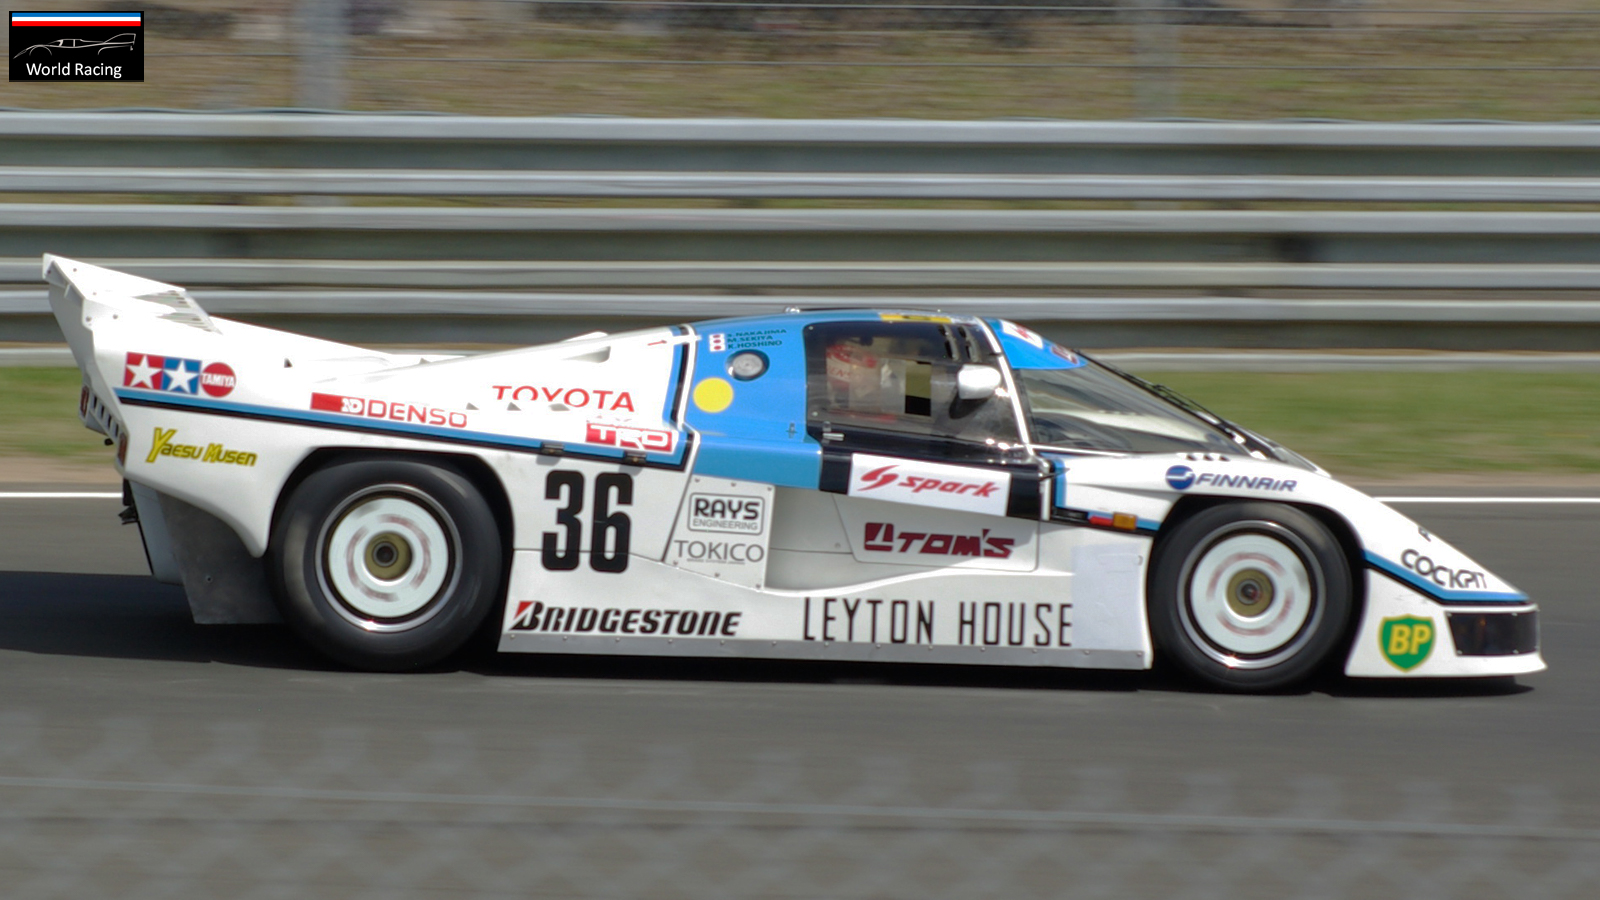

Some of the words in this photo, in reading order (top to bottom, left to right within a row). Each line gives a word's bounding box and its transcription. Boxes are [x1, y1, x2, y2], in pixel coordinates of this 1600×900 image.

[201, 372, 235, 388] TAMIYA
[492, 385, 635, 412] TOYOTA
[367, 400, 467, 428] DENSO
[898, 475, 1001, 498] spark
[1194, 472, 1298, 492] FINNAIR
[693, 497, 760, 520] RAYS
[541, 469, 633, 574] 36
[692, 517, 758, 530] ENGINEERING
[673, 540, 765, 563] TOKICO
[508, 601, 743, 636] BRIDGESTONE
[803, 597, 934, 643] LEYTON
[959, 601, 1073, 647] HOUSE
[1388, 623, 1431, 655] BP
